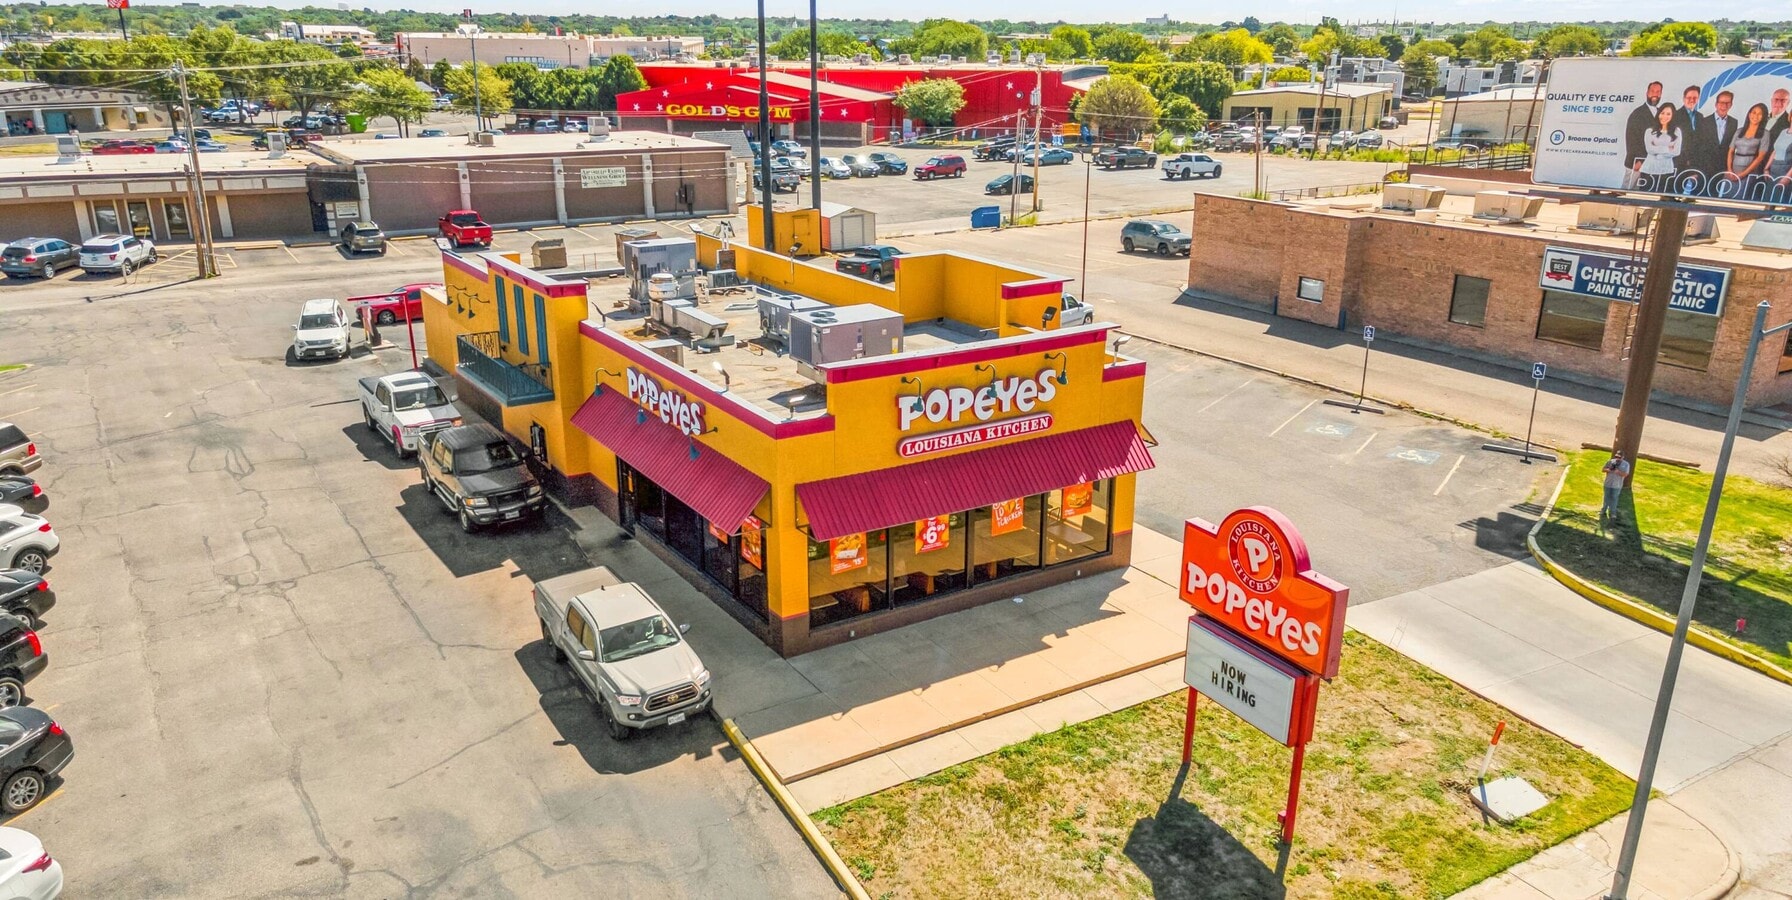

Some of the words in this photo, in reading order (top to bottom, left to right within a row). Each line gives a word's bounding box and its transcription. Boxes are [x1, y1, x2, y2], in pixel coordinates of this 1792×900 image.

[1547, 93, 1586, 101] QUALITY
[1609, 95, 1635, 103] CARE
[1562, 105, 1589, 113] SINCE
[1593, 106, 1614, 114] 1929
[666, 104, 741, 118] GOLD'S
[744, 106, 792, 119] GM
[1593, 136, 1618, 144] Optical
[1553, 263, 1568, 272] BEST
[1587, 283, 1614, 295] PAIN
[1670, 294, 1706, 310] LINIC
[905, 430, 981, 456] LOUISIANA
[986, 416, 1050, 440] KITCHEN
[1231, 522, 1281, 561] LOUISIANA
[1243, 537, 1269, 572] P
[1233, 559, 1279, 592] KITCHEN
[1221, 661, 1246, 685] NOW
[1211, 671, 1256, 708] HIRING
